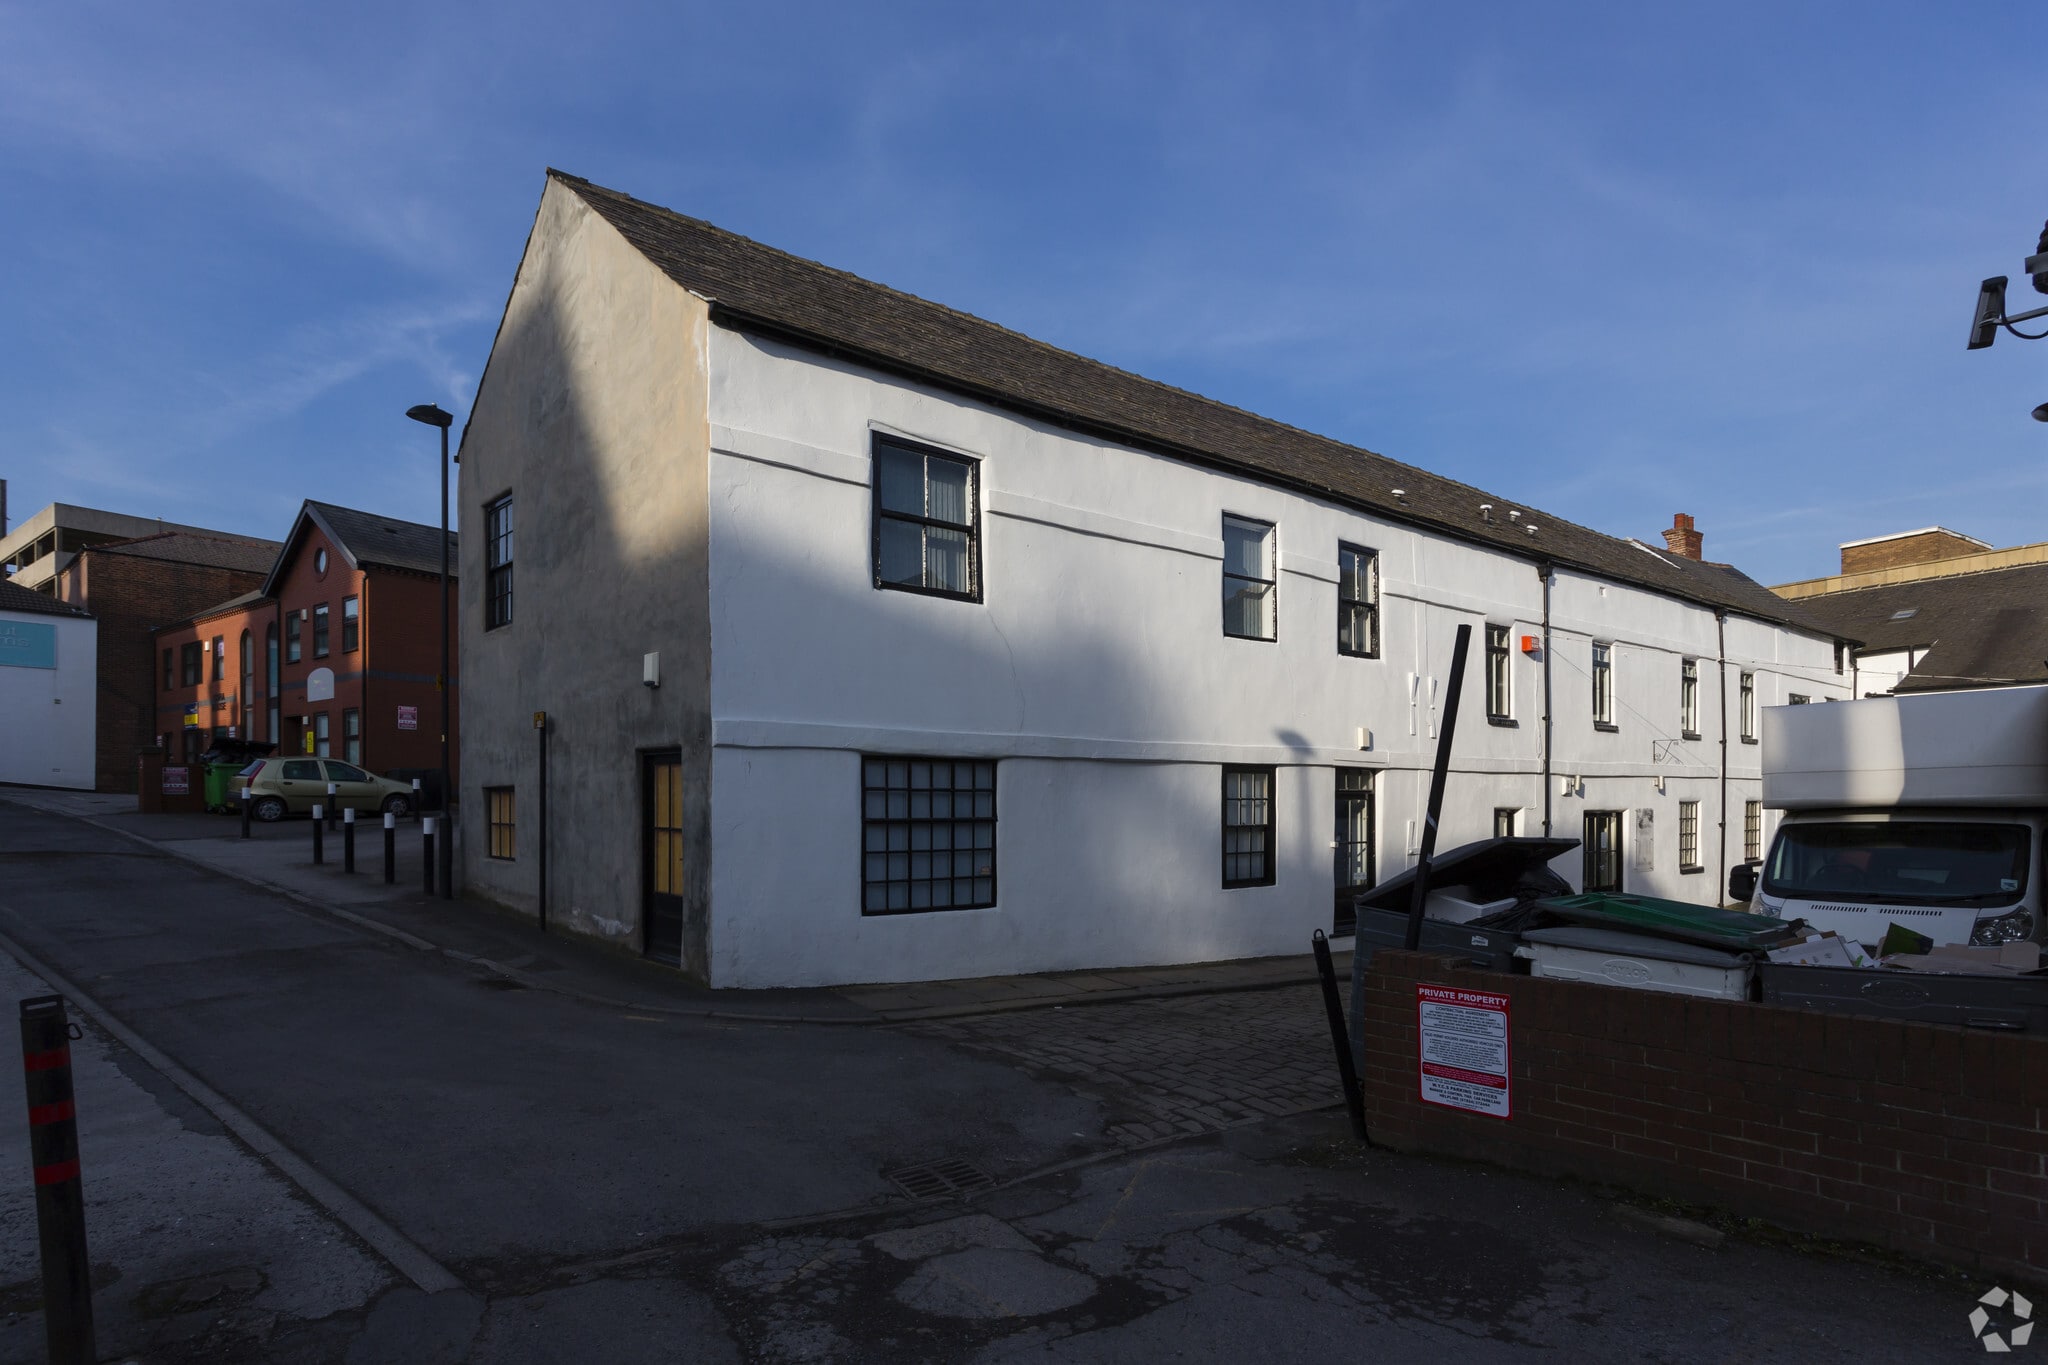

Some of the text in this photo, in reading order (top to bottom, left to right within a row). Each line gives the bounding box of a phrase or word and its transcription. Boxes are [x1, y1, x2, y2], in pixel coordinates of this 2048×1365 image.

[1604, 963, 1649, 980] TAYLOR
[1418, 988, 1507, 1006] PRIVATE PROPERTY
[1450, 1086, 1472, 1095] PARKING
[1473, 1091, 1498, 1099] SERVICES
